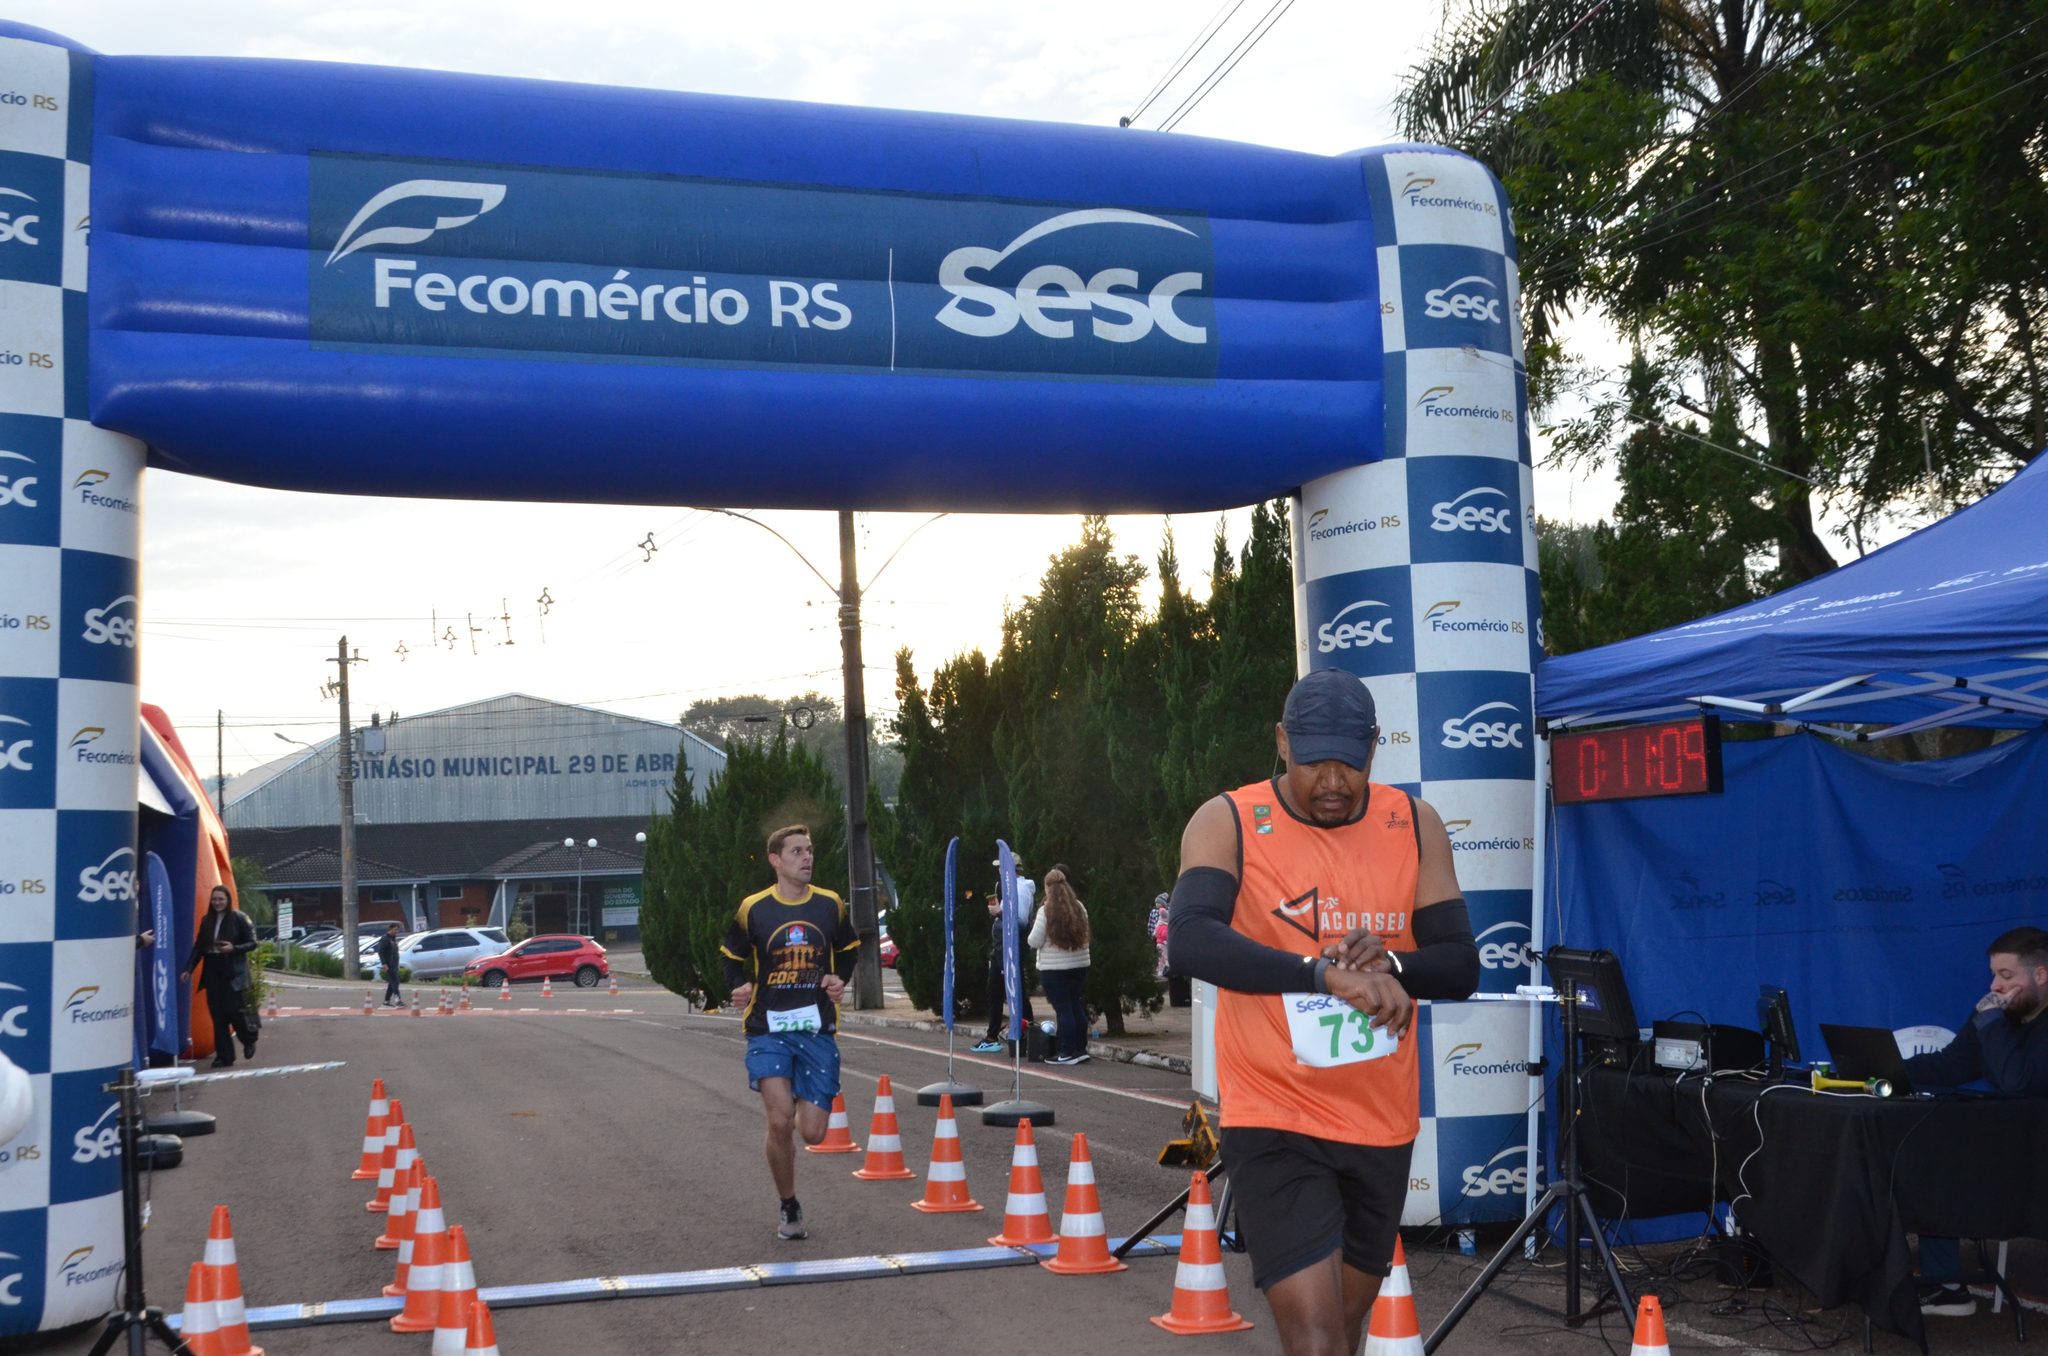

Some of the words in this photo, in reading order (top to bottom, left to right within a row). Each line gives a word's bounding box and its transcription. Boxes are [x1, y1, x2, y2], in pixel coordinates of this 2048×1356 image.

[33, 94, 58, 112] RS
[1411, 195, 1482, 212] Fecomércio
[1484, 203, 1497, 217] RS
[373, 258, 749, 328] Fecomércio
[769, 281, 852, 332] RS
[934, 246, 1208, 345] Sesc
[1424, 288, 1501, 323] Sesc
[29, 352, 54, 368] RS
[1426, 404, 1499, 421] Fecomércio
[1502, 409, 1514, 423] RS
[1311, 518, 1377, 541] Fecomércio
[1380, 515, 1401, 529] RS
[1430, 501, 1511, 534] Sesc
[26, 614, 51, 631] RS
[82, 608, 138, 648] Ses
[1432, 619, 1508, 633] Fecomércio
[1511, 622, 1525, 635] RS
[1317, 617, 1393, 653] Sesc
[1391, 731, 1411, 745] RS
[1440, 718, 1523, 749] Sesc
[350, 755, 435, 780] GINÁSIO
[443, 755, 562, 777] MUNICIPAL
[569, 754, 596, 774] 29
[602, 754, 629, 773] DE
[635, 753, 694, 773] ABR
[21, 878, 46, 894] RS
[1319, 1009, 1374, 1058] 73
[16, 1144, 41, 1161] RS
[1410, 1178, 1430, 1191] RS
